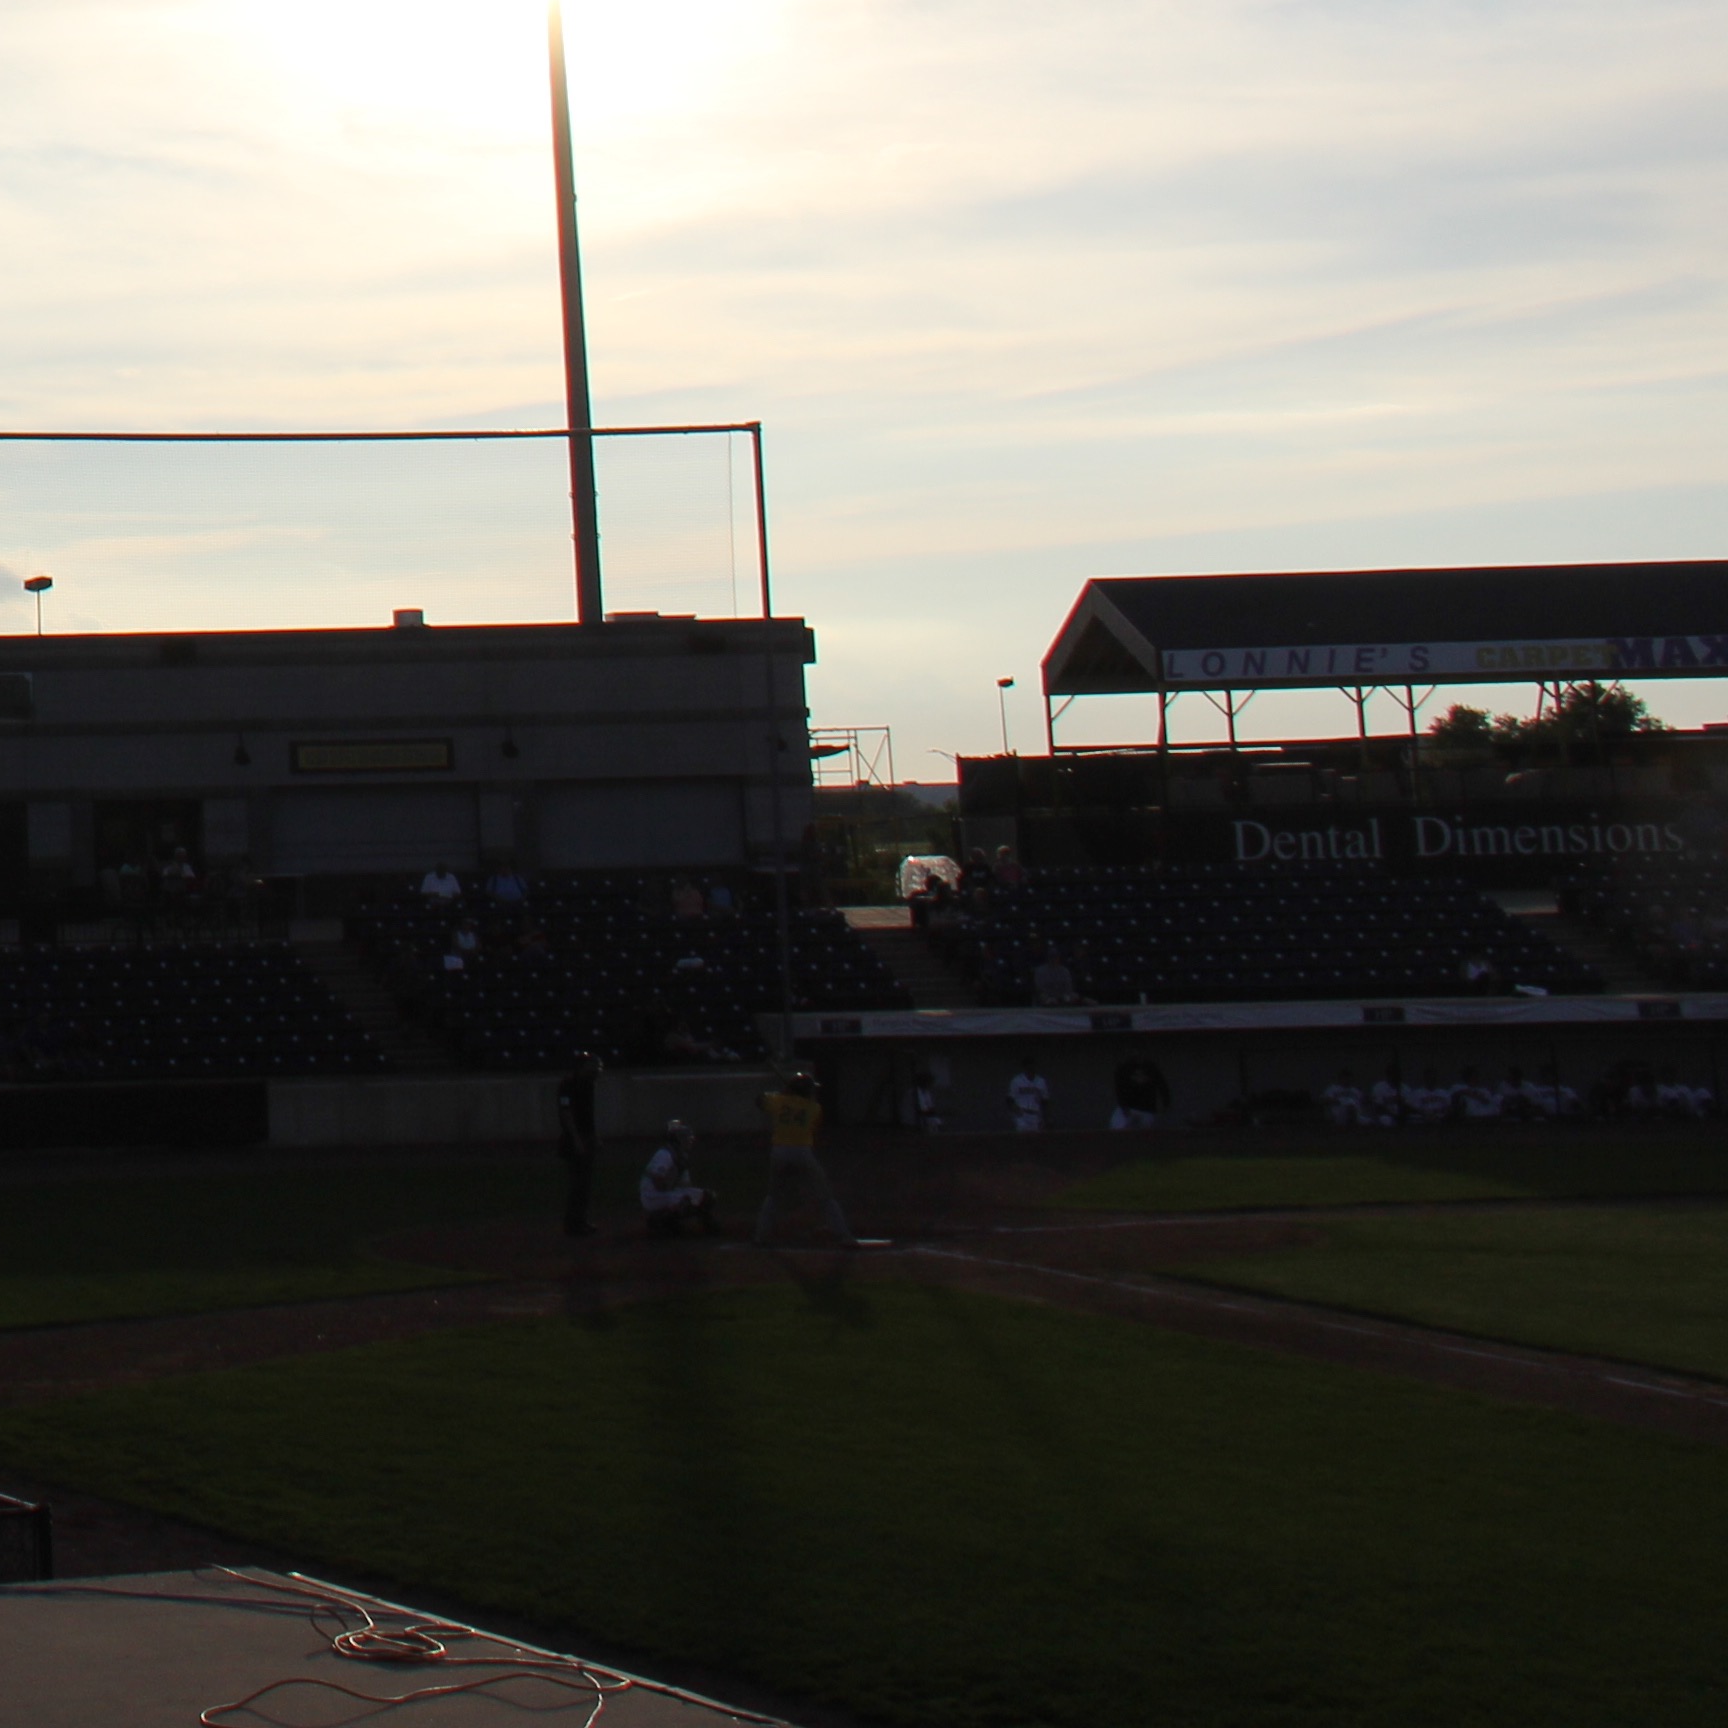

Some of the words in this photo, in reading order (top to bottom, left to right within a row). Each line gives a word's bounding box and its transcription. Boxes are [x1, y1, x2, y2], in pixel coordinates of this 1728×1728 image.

[1163, 644, 1431, 680] LONNIE'S
[1475, 643, 1619, 669] CARPET
[1232, 817, 1385, 862] Dental
[1412, 812, 1685, 859] Dimensions
